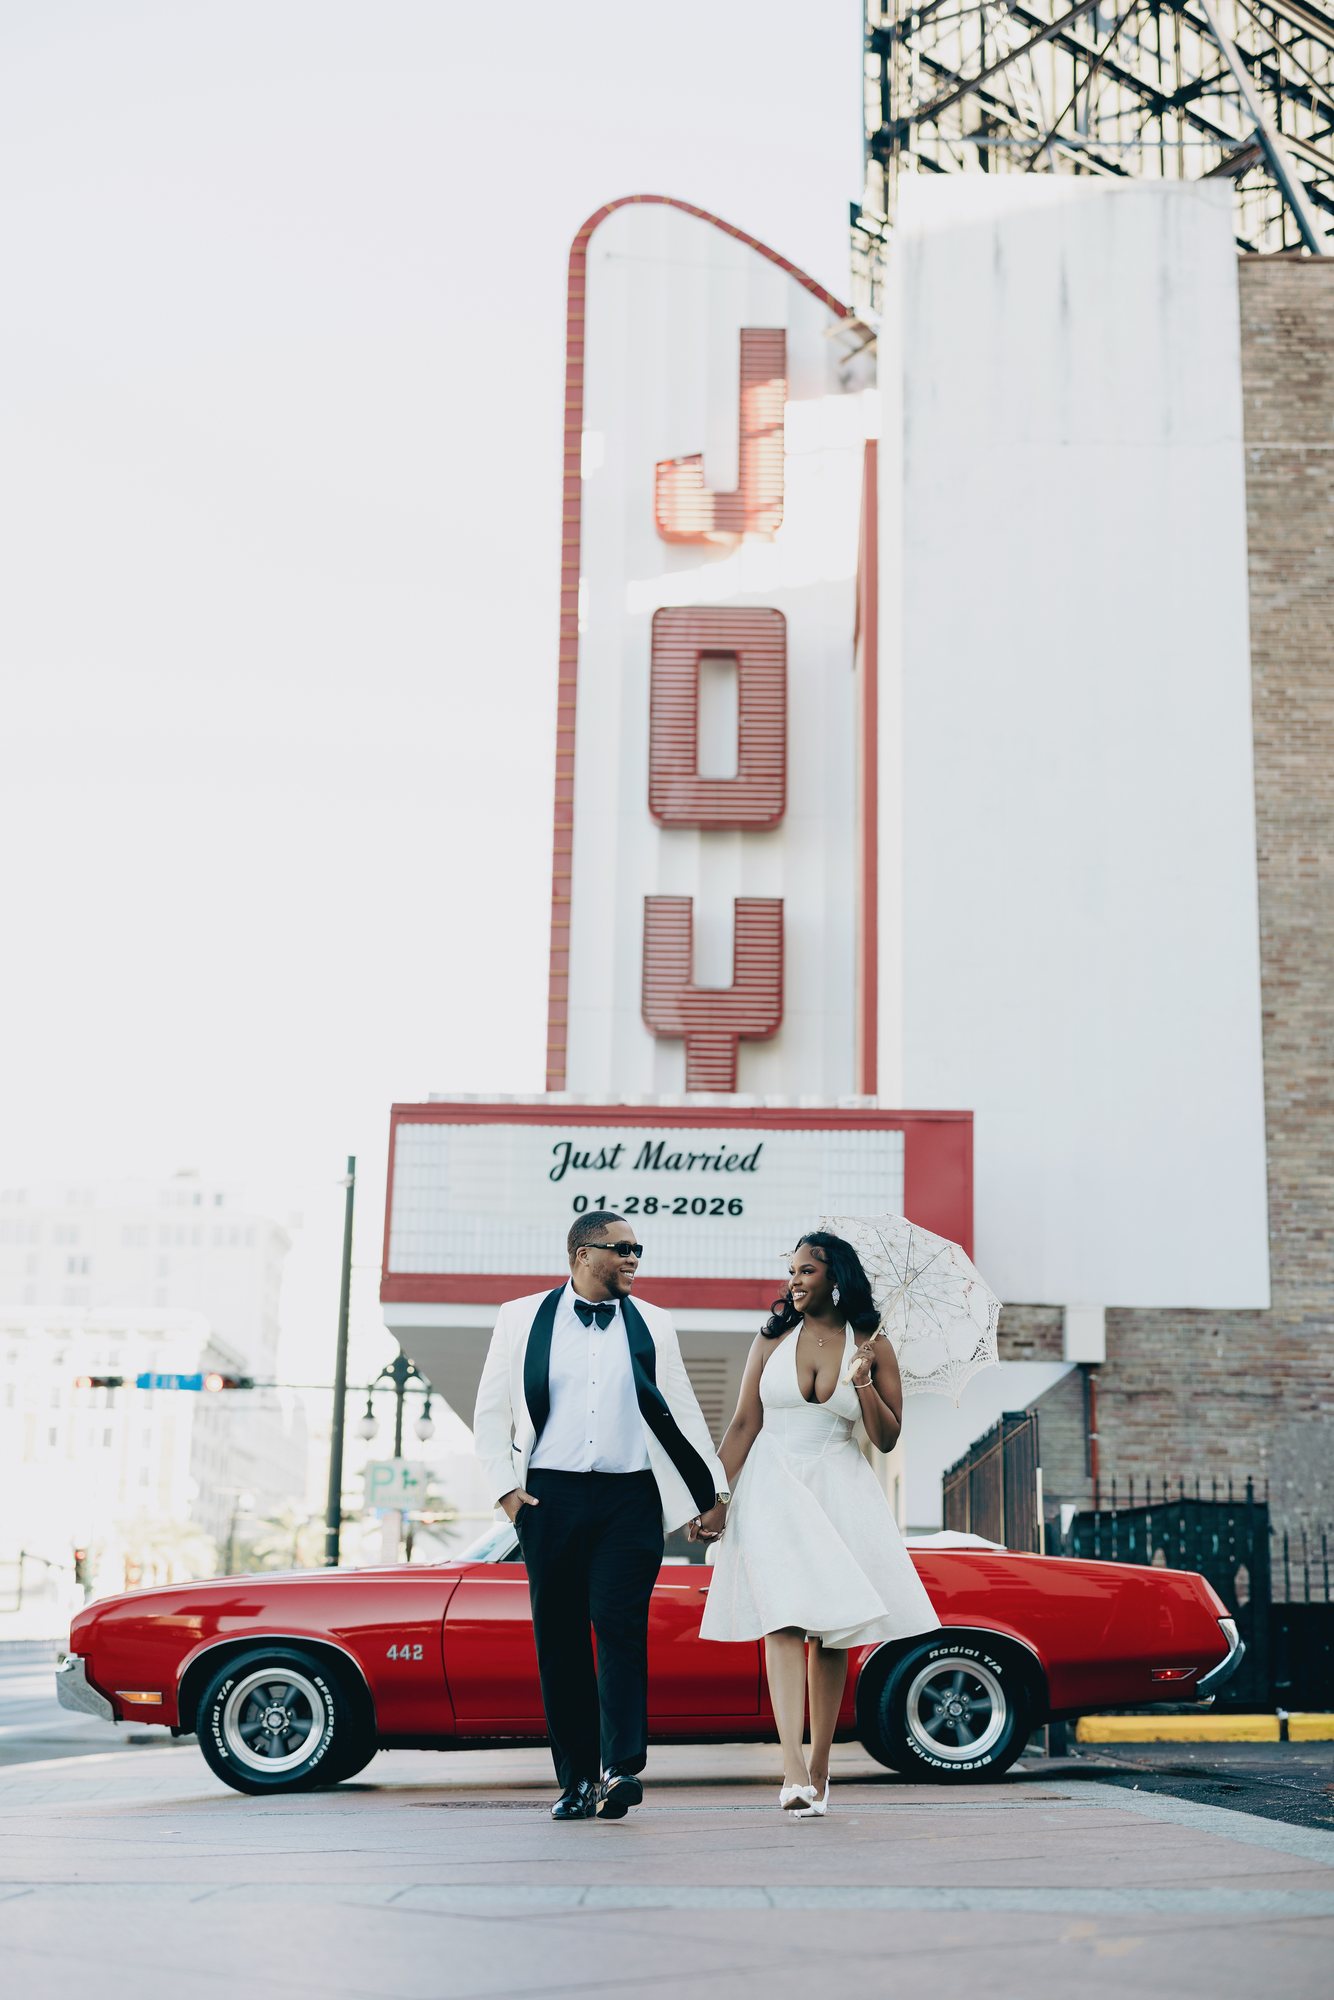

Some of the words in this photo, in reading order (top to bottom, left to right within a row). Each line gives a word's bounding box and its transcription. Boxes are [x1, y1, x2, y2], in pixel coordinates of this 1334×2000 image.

[641, 327, 788, 1093] JOY
[549, 1142, 625, 1182] Just
[633, 1140, 764, 1172] Married
[572, 1195, 744, 1216] 01-28-2026
[386, 1644, 423, 1660] 442
[928, 1645, 980, 1659] Radial
[983, 1654, 1003, 1675] T/A
[217, 1679, 235, 1701] T/A
[211, 1705, 229, 1758] Radial
[309, 1676, 335, 1768] BFGoodrich
[905, 1736, 993, 1770] BFGoodrich
